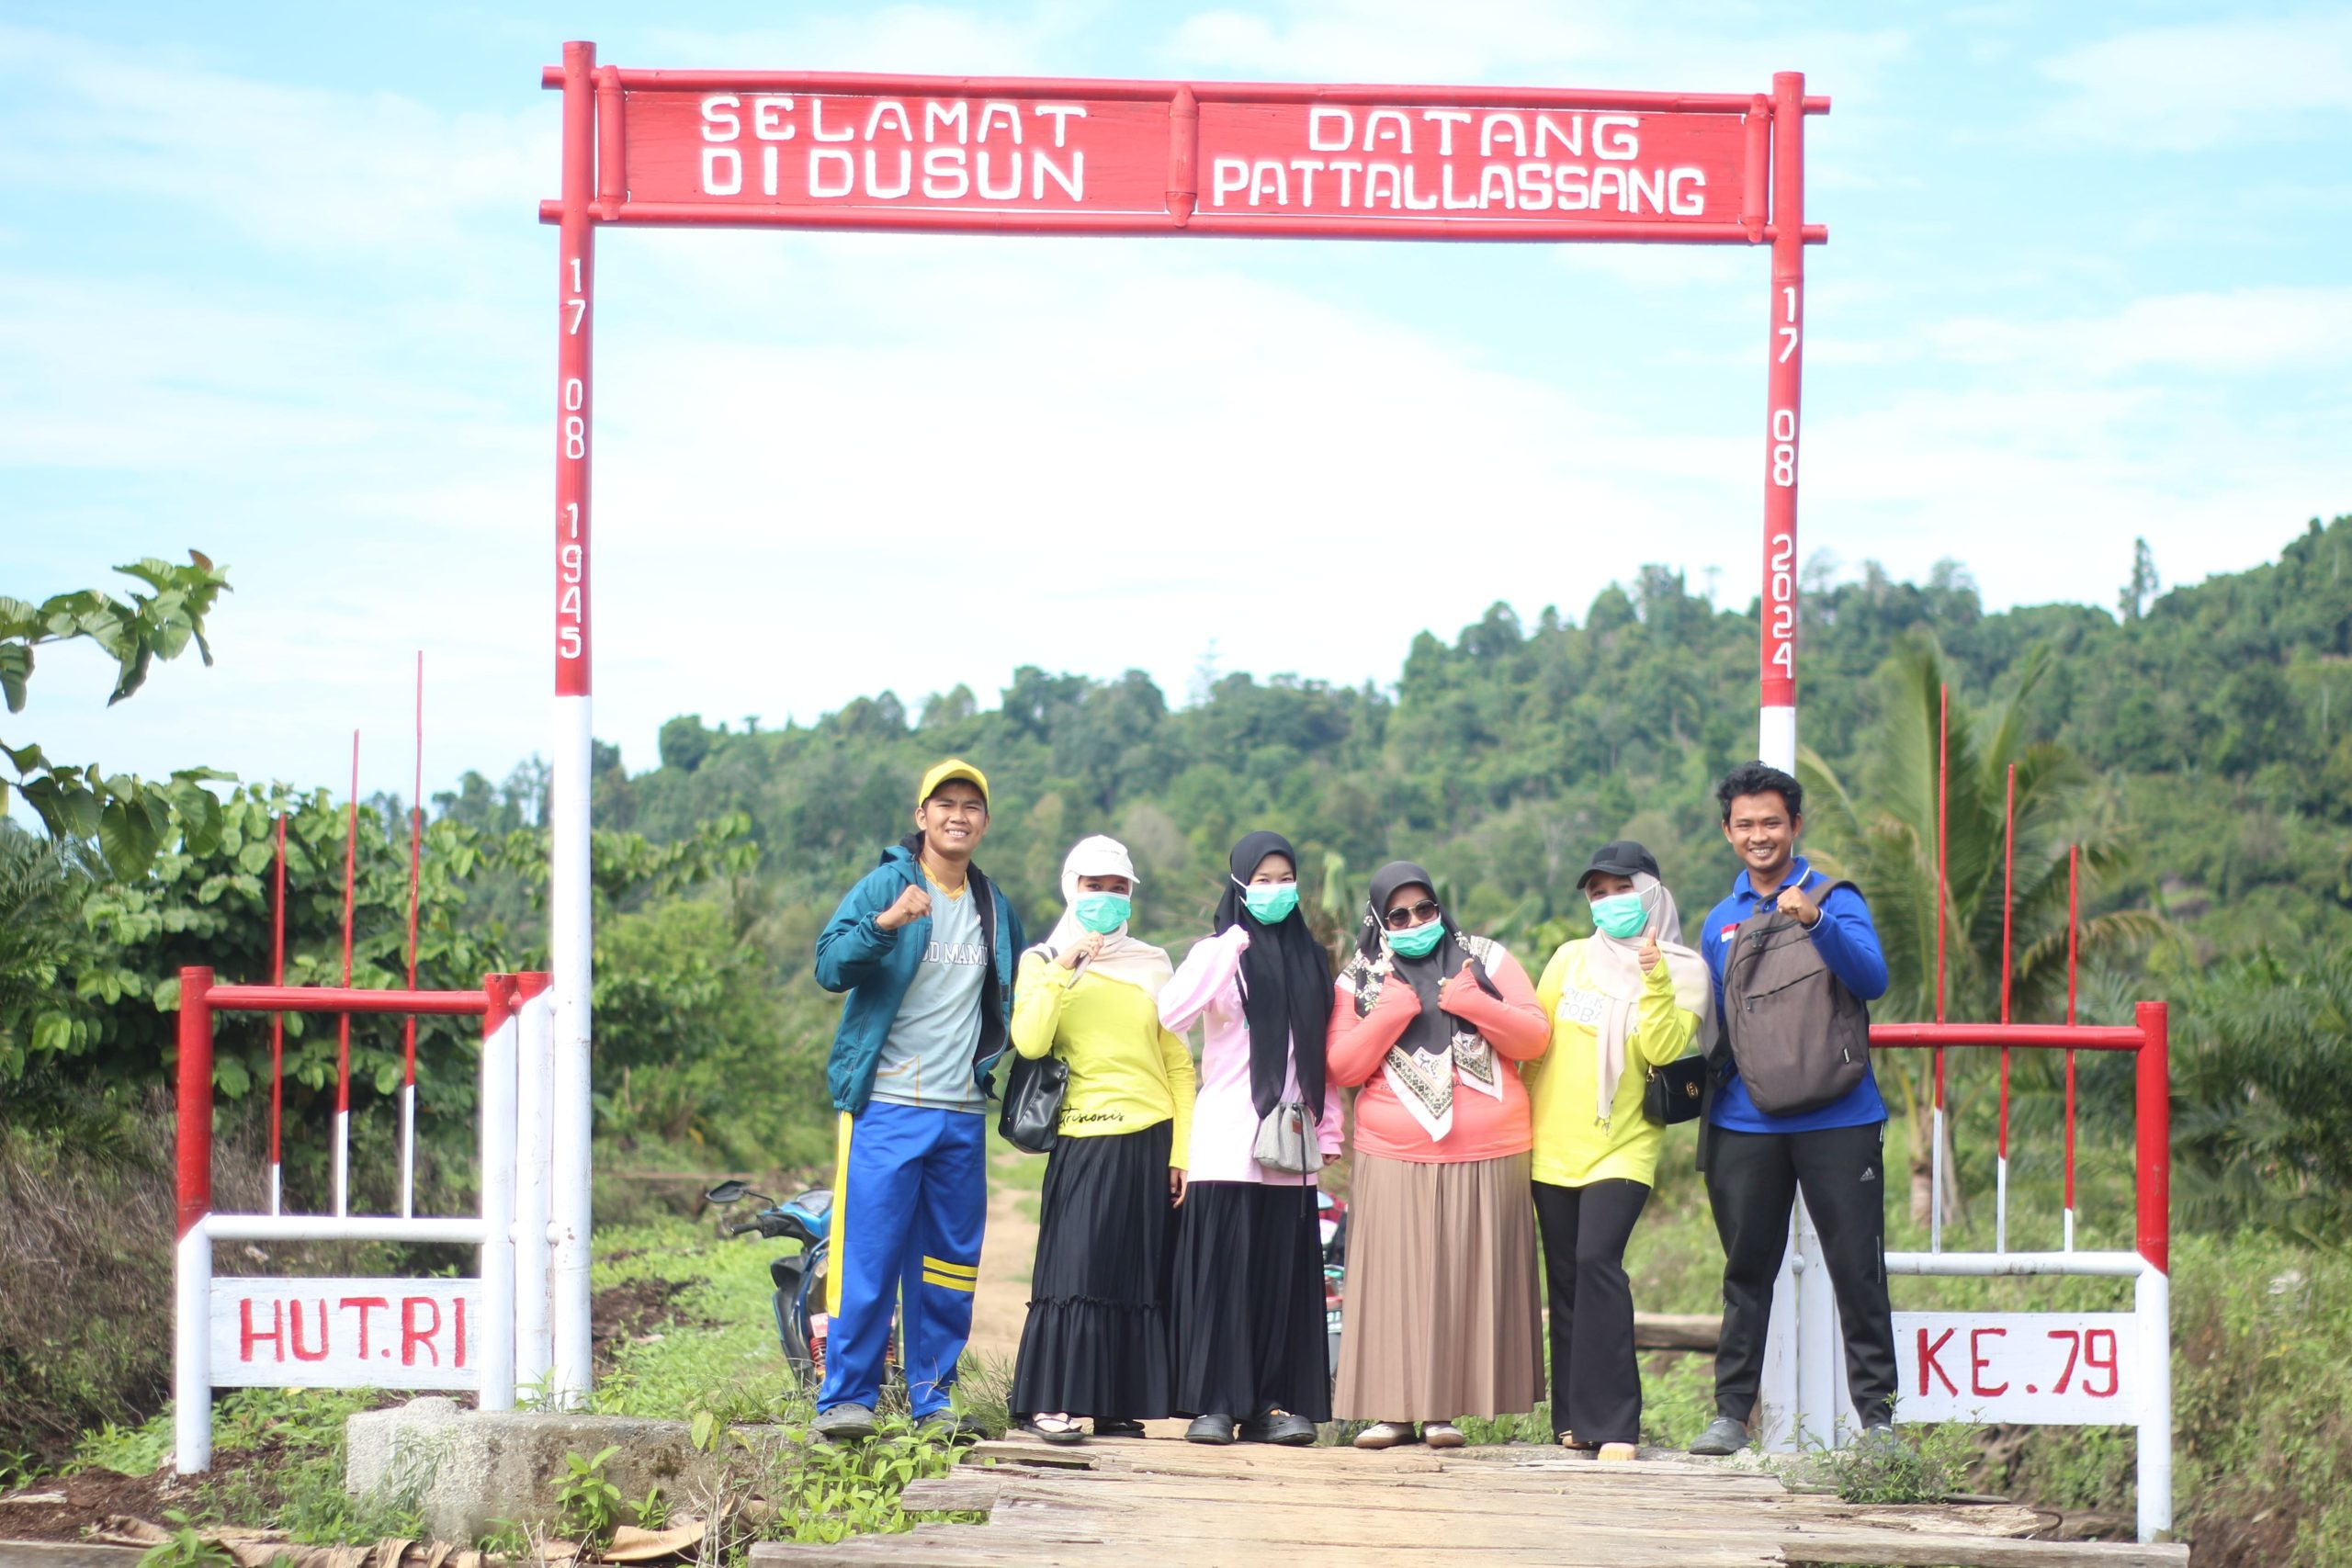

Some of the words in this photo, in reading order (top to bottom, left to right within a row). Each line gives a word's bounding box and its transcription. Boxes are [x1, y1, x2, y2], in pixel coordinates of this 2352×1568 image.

[700, 95, 1088, 148] SELAMAT
[1308, 105, 1640, 161] DATANG
[701, 145, 778, 196] DI
[808, 146, 1084, 202] DUSUN
[1213, 157, 1707, 216] PATTALLASSANG
[568, 257, 586, 335] 17
[1778, 286, 1798, 364] 17
[564, 378, 585, 459] 08
[1772, 409, 1795, 487] 08
[560, 502, 583, 659] 1945
[1770, 533, 1793, 680] 2024
